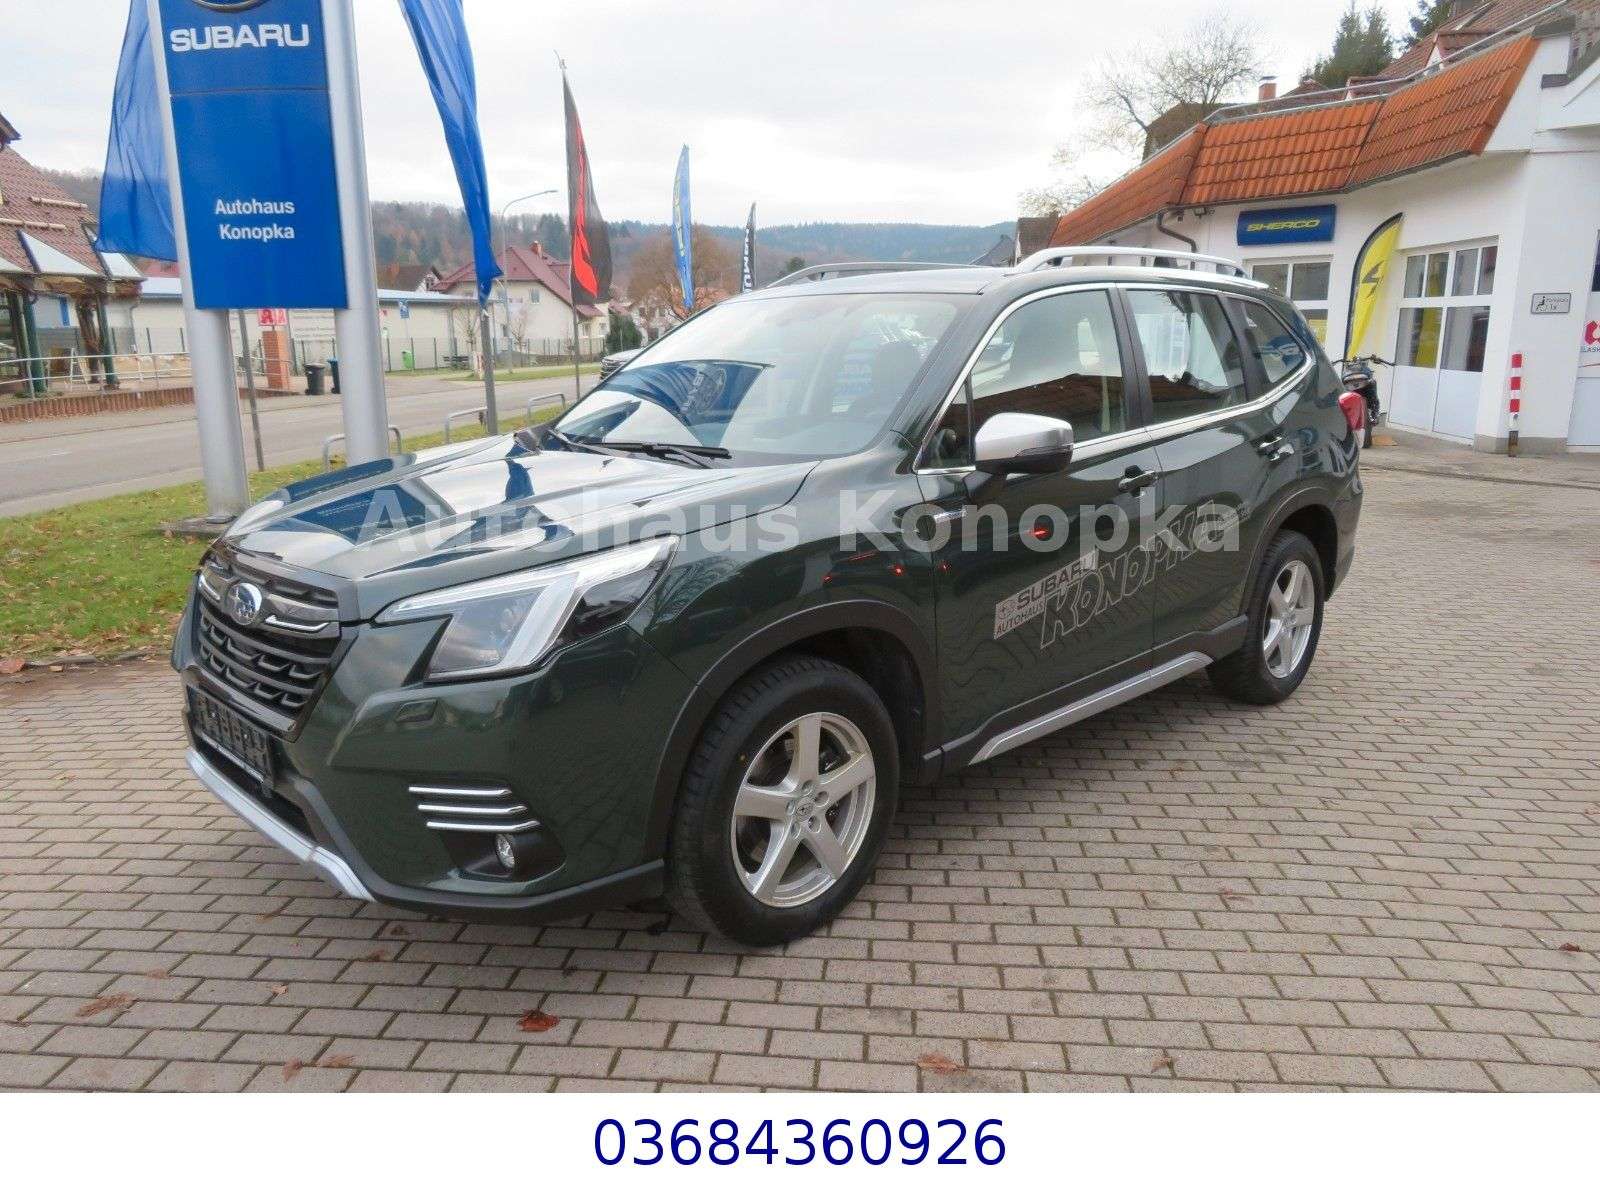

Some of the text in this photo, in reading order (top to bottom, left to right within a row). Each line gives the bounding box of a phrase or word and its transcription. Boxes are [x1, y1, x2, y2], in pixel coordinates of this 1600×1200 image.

[169, 23, 310, 52] SUBARU
[214, 198, 296, 215] Autohaus
[219, 222, 296, 243] Konopka
[996, 602, 1045, 635] AUTOHAUS
